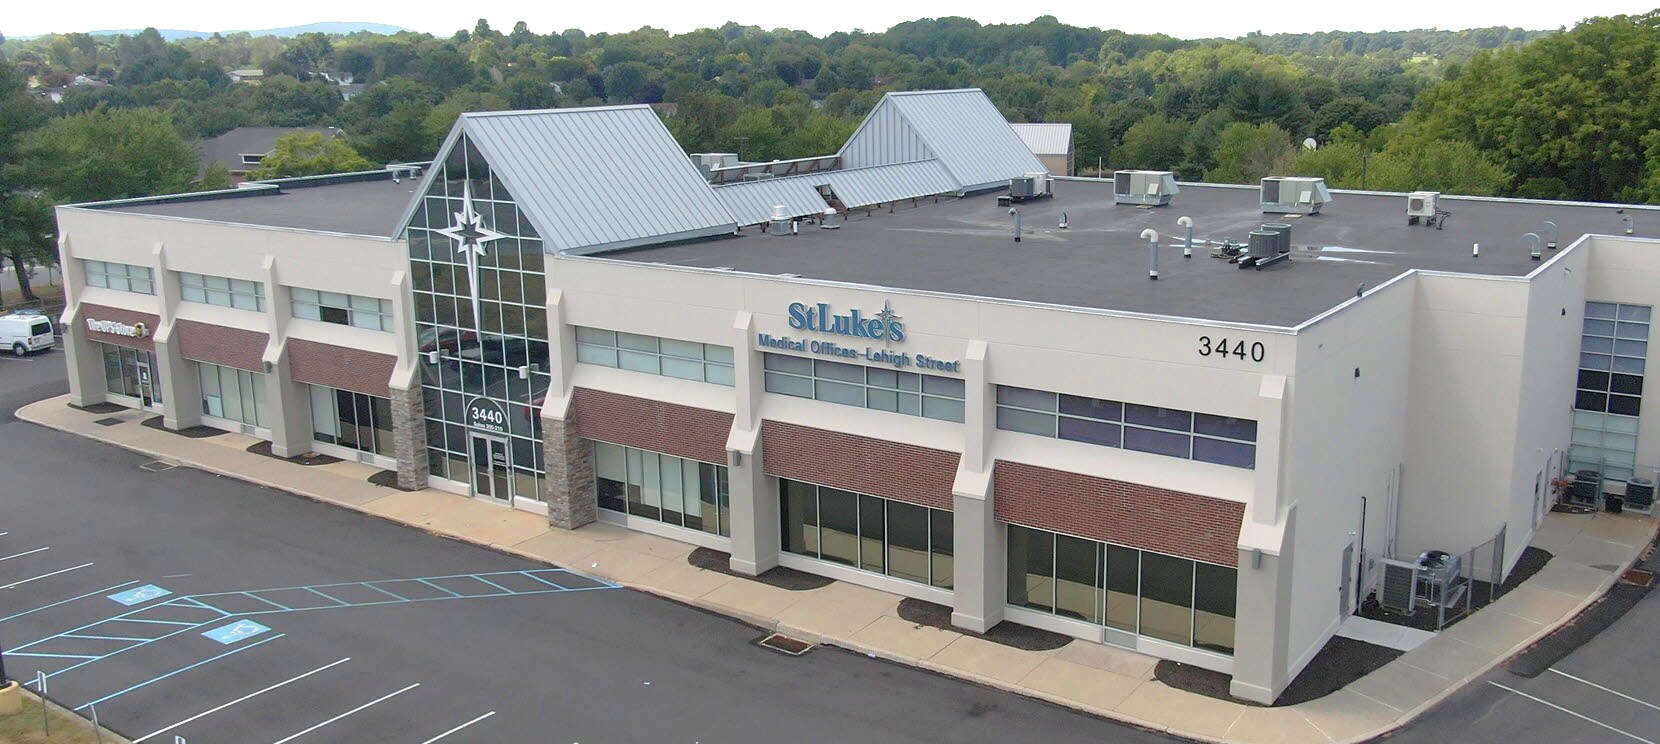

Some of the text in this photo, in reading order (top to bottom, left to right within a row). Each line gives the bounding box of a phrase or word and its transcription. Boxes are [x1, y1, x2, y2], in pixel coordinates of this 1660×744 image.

[758, 333, 807, 352] Medical
[916, 353, 960, 373] Street
[1198, 336, 1265, 362] 3440
[472, 407, 502, 424] 3440
